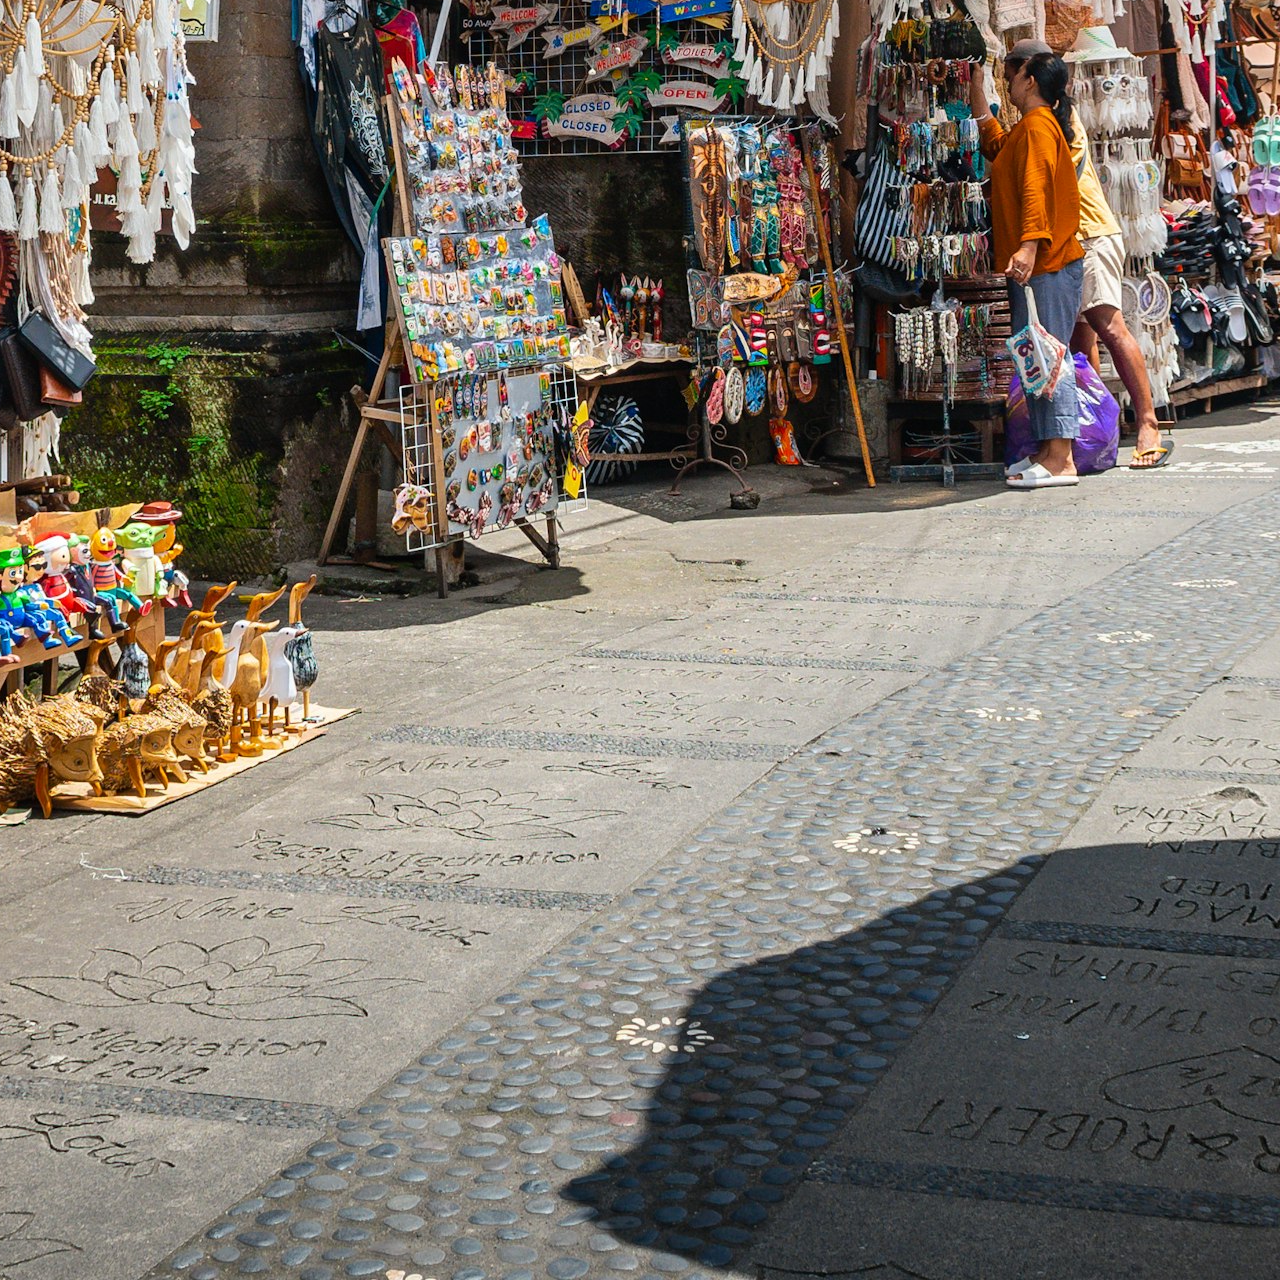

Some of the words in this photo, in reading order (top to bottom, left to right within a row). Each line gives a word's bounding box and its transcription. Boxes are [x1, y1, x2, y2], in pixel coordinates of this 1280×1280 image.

[499, 8, 538, 22] WELLCOME
[462, 19, 474, 28] GO
[563, 26, 592, 45] BEACH
[676, 47, 715, 58] TOILET
[663, 87, 708, 99] OPEN
[564, 101, 611, 114] CLOSED
[561, 119, 607, 134] CLOSED
[57, 1028, 328, 1058] Meditation
[94, 1060, 211, 1086] 2012
[902, 1097, 1177, 1163] ROBERT
[1187, 1132, 1239, 1163] &
